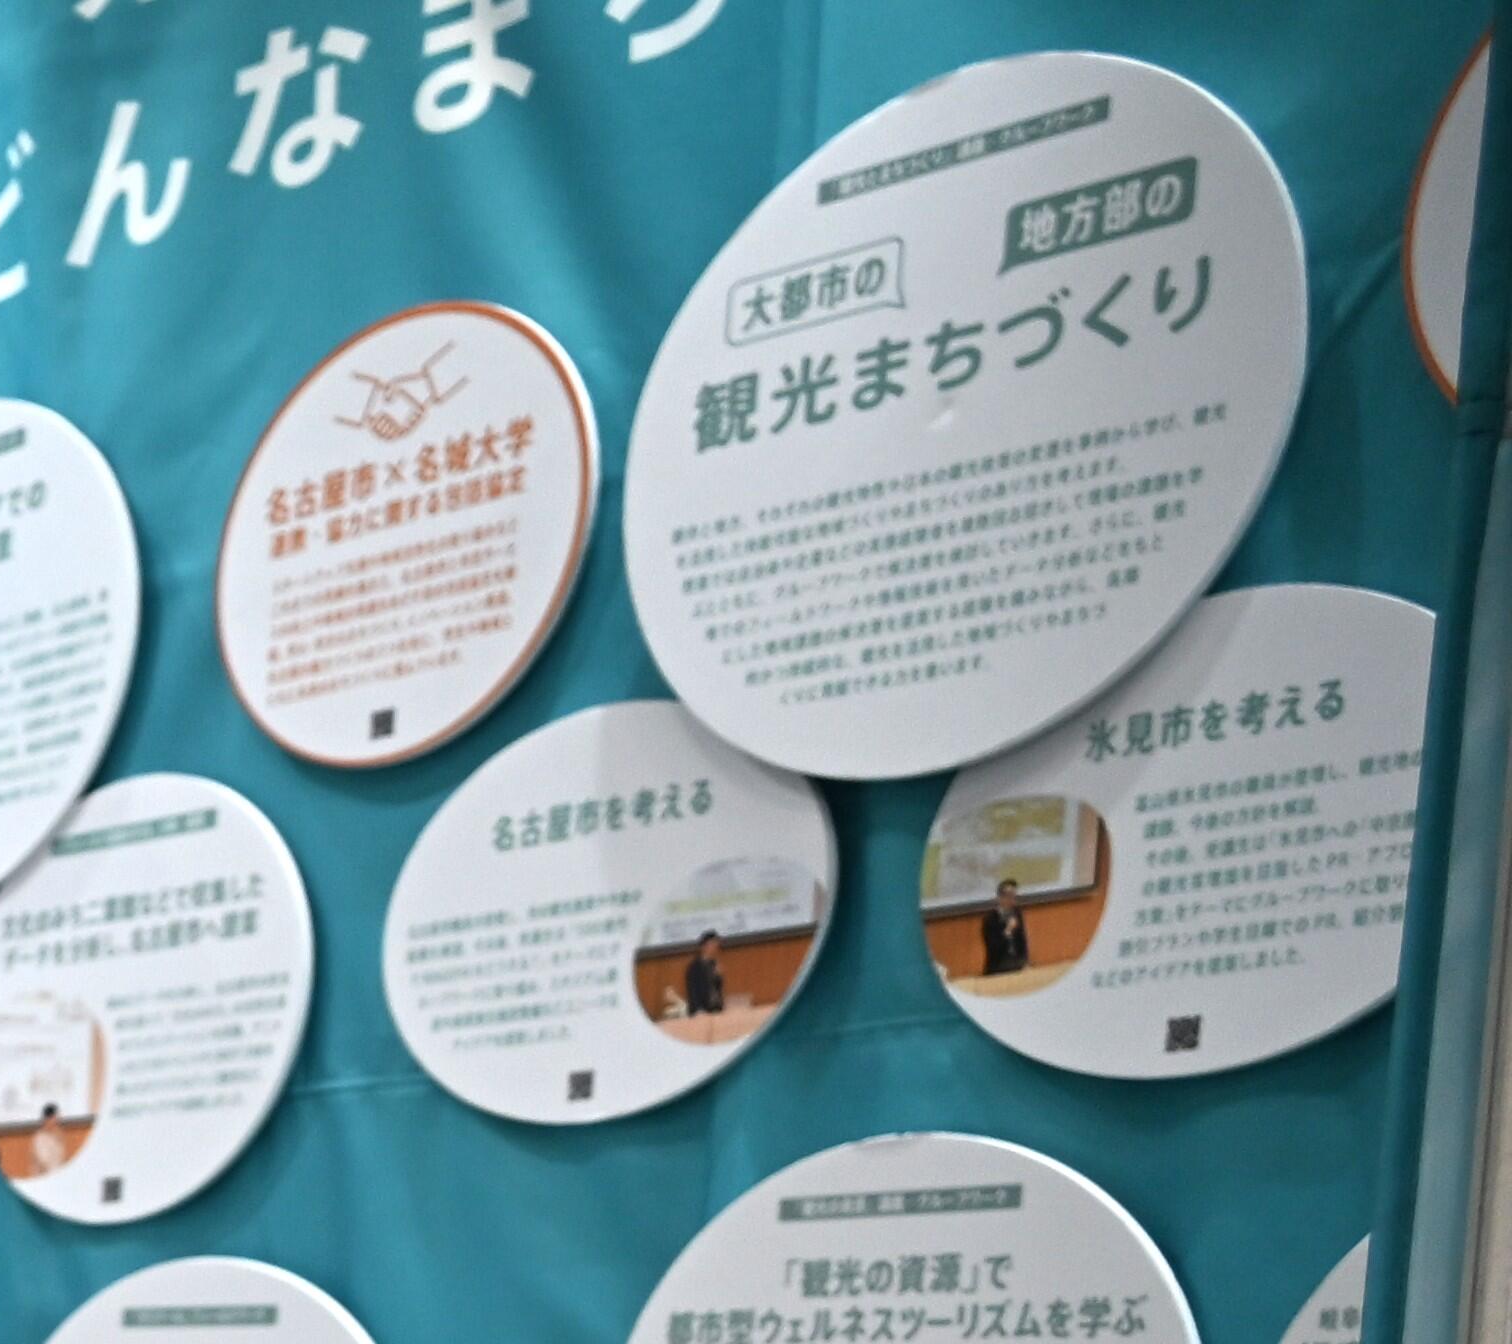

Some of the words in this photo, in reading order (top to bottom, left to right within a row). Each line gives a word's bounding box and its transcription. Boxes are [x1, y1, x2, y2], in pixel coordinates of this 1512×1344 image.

[1020, 173, 1182, 252] 地方部の
[739, 255, 886, 331] 大都市の
[691, 253, 1214, 454] 観光まちづくり
[266, 415, 536, 527] 名古屋市×名城大学
[1084, 678, 1346, 764] 氷見市を考える
[491, 778, 714, 854] 名古屋市を考える
[782, 1252, 1013, 1301] 「観光の資源」で
